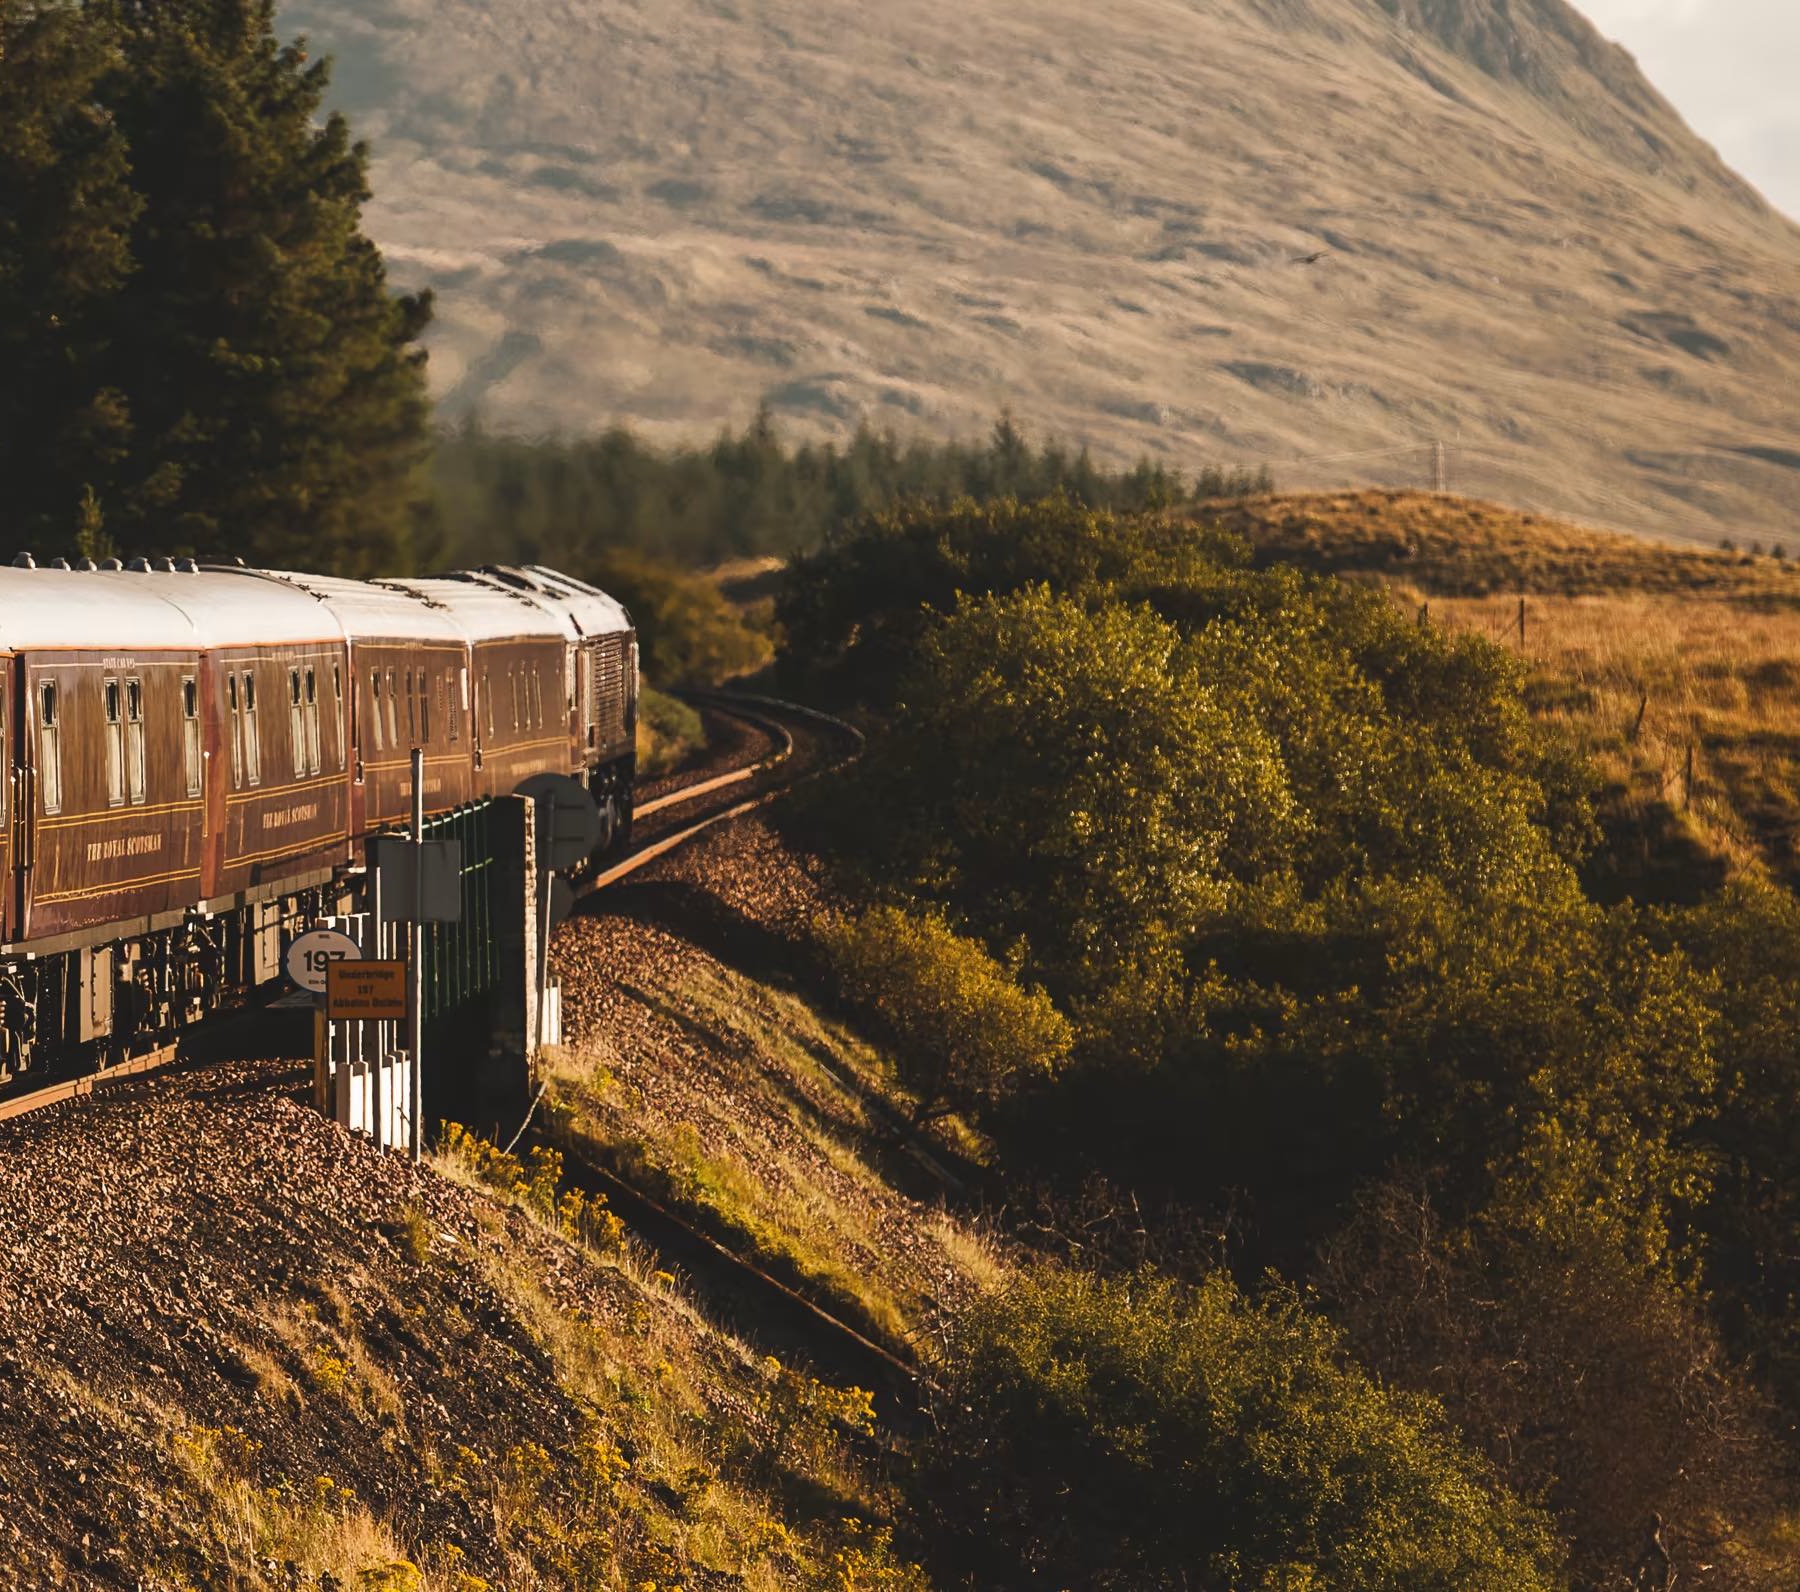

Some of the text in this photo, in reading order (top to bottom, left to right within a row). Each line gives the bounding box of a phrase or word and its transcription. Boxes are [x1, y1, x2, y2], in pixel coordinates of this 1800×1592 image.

[87, 833, 162, 862] THE ROYAL SCOTSMAN
